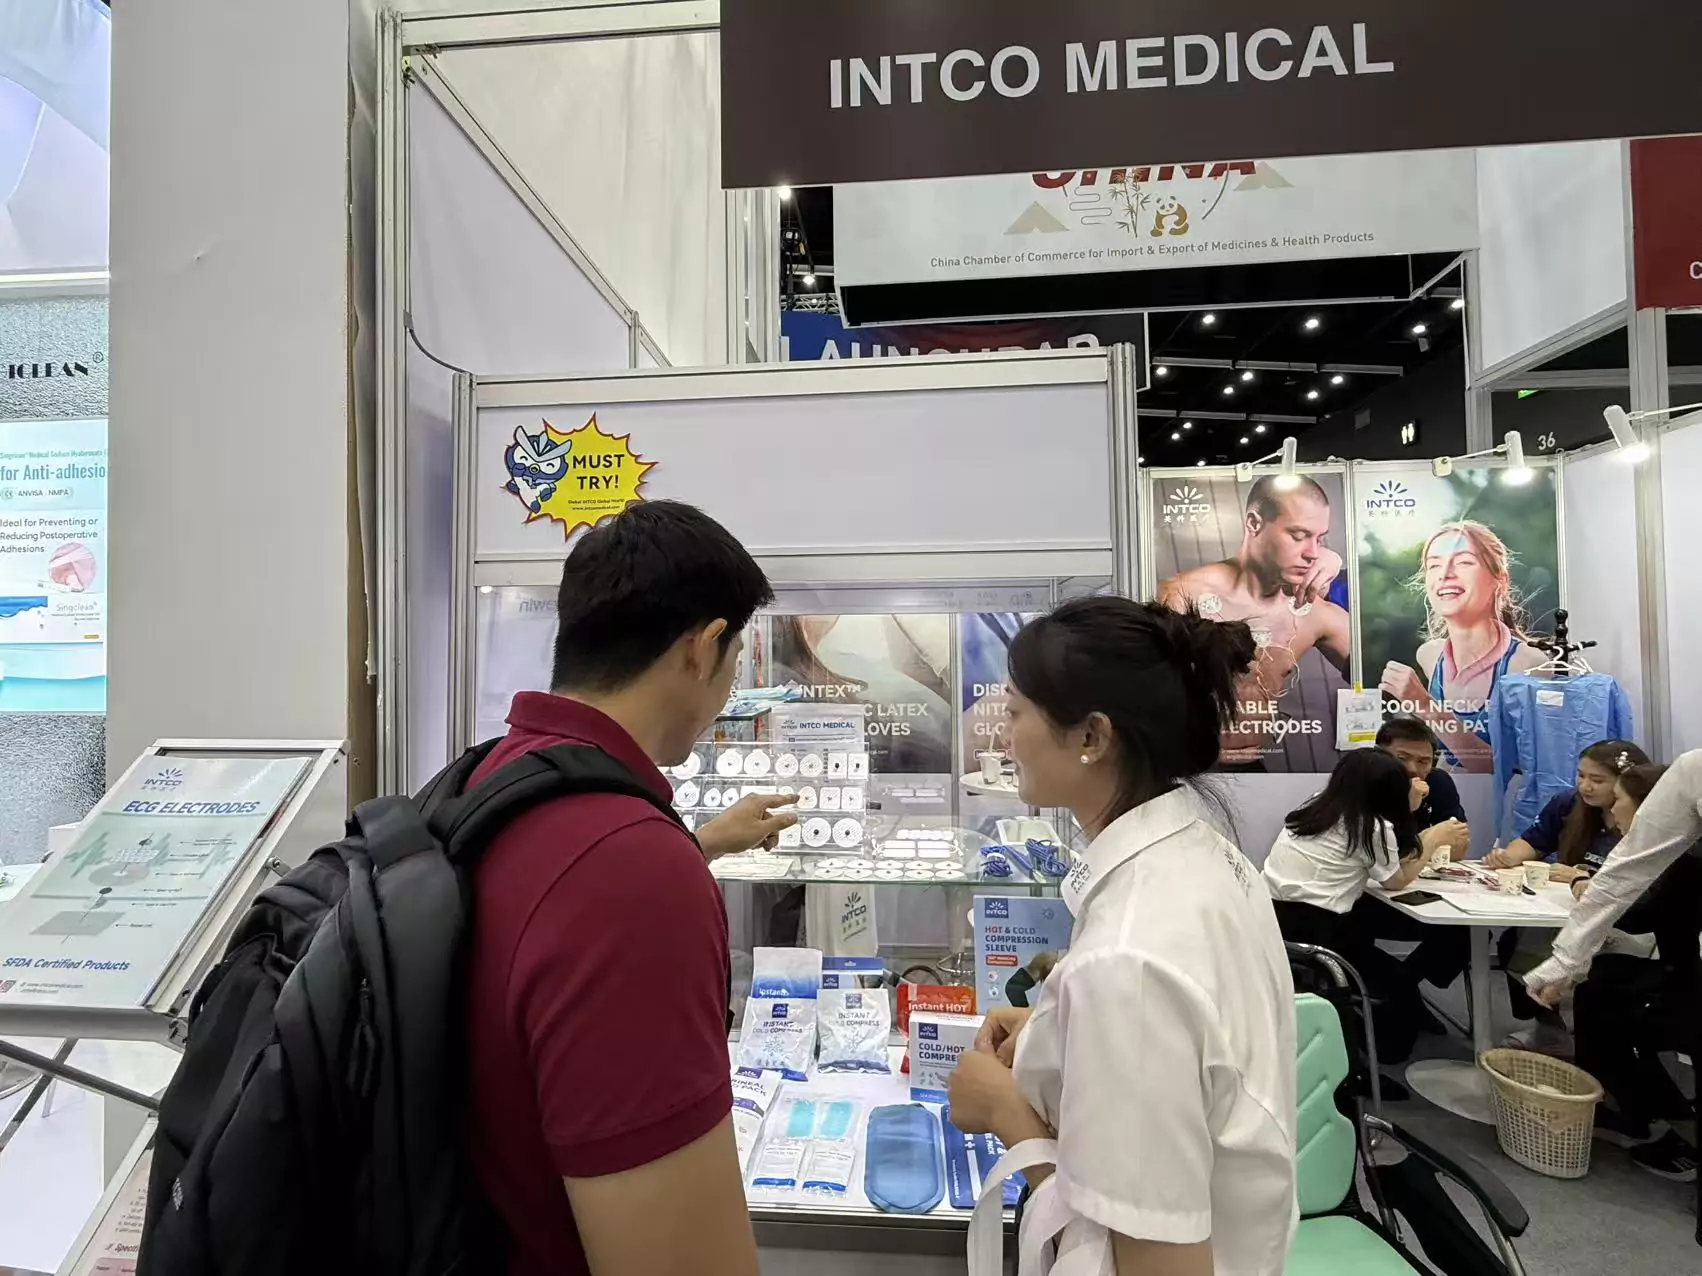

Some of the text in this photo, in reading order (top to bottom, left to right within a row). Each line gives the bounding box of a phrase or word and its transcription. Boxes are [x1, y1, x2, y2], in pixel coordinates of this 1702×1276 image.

[829, 22, 1396, 109] INTCO MEDICAL
[930, 232, 1375, 268] China Chamber of Commerce for Import & Export of Medicines & Health Products
[1537, 431, 1556, 450] 36
[572, 454, 625, 469] MUST
[0, 466, 19, 481] for
[576, 474, 619, 490] TRY!
[18, 489, 44, 497] ANVISA
[48, 488, 69, 496] NMPA
[1162, 503, 1211, 514] INTCO
[1366, 499, 1416, 509] INTCO
[0, 516, 99, 528] Ideal for Preventing or
[0, 530, 98, 542] Reducing Postoperative
[0, 544, 45, 553] Adhesions
[877, 702, 929, 717] LATEX
[1429, 699, 1480, 714] NECK
[822, 721, 856, 729] MEDICAL
[145, 778, 182, 787] INTCO
[123, 800, 261, 814] ECG ELECTRODES
[985, 926, 1036, 935] HOT & COLD
[985, 934, 1049, 945] COMPRESSION
[985, 943, 1017, 953] SLEEVE
[2, 957, 131, 971] SFDA Certified Products
[908, 1001, 968, 1013] Instant HOT
[918, 1042, 966, 1054] COLD/HOT
